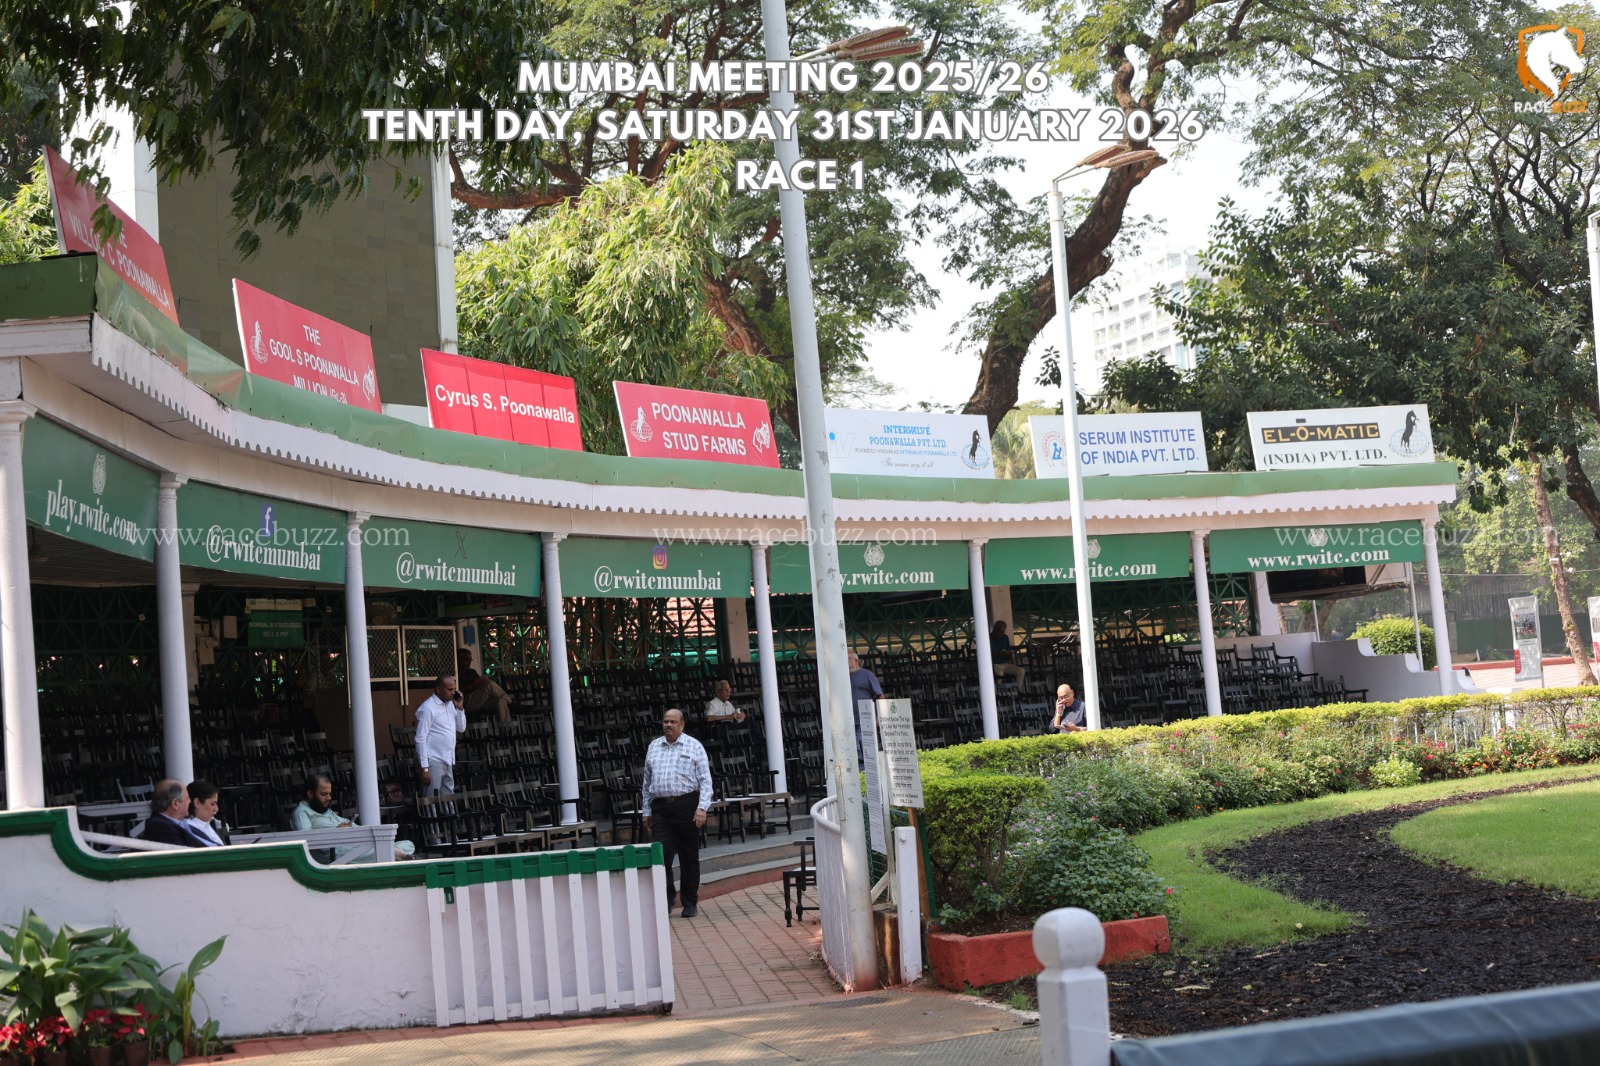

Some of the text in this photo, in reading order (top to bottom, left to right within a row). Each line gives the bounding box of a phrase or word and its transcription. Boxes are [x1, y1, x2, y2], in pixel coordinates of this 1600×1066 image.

[107, 242, 115, 265] C
[116, 249, 171, 310] POONAWALLA
[303, 325, 321, 346] THE
[269, 338, 296, 363] GOOL
[296, 348, 303, 366] S
[304, 352, 360, 387] POONAWALLA
[435, 384, 575, 424] Cyrus S. Poonawalla
[651, 402, 747, 430] POONAWALLA
[883, 424, 931, 436] INTERVALVE
[1079, 429, 1196, 446] SERUM INSTITUTE
[1263, 424, 1380, 443] EL-O-MATIC
[662, 431, 699, 452] STUD
[701, 436, 748, 456] FARMS
[869, 436, 916, 447] POONAWALLA
[933, 440, 948, 449] LTD.
[1081, 447, 1199, 465] OF INDIA PVT. LTD.
[1263, 453, 1316, 467] (INDIA)
[1320, 450, 1352, 462] PVT.
[1356, 448, 1387, 460] LTD.
[45, 480, 137, 543] play.rwitc.com
[206, 525, 321, 571] @rwitcmumbai
[1247, 549, 1391, 568] www.rwitc.com
[396, 552, 516, 587] @rwitcmumbai
[594, 565, 722, 593] @rwitcmumbai
[1020, 561, 1157, 581] www.ritc.com
